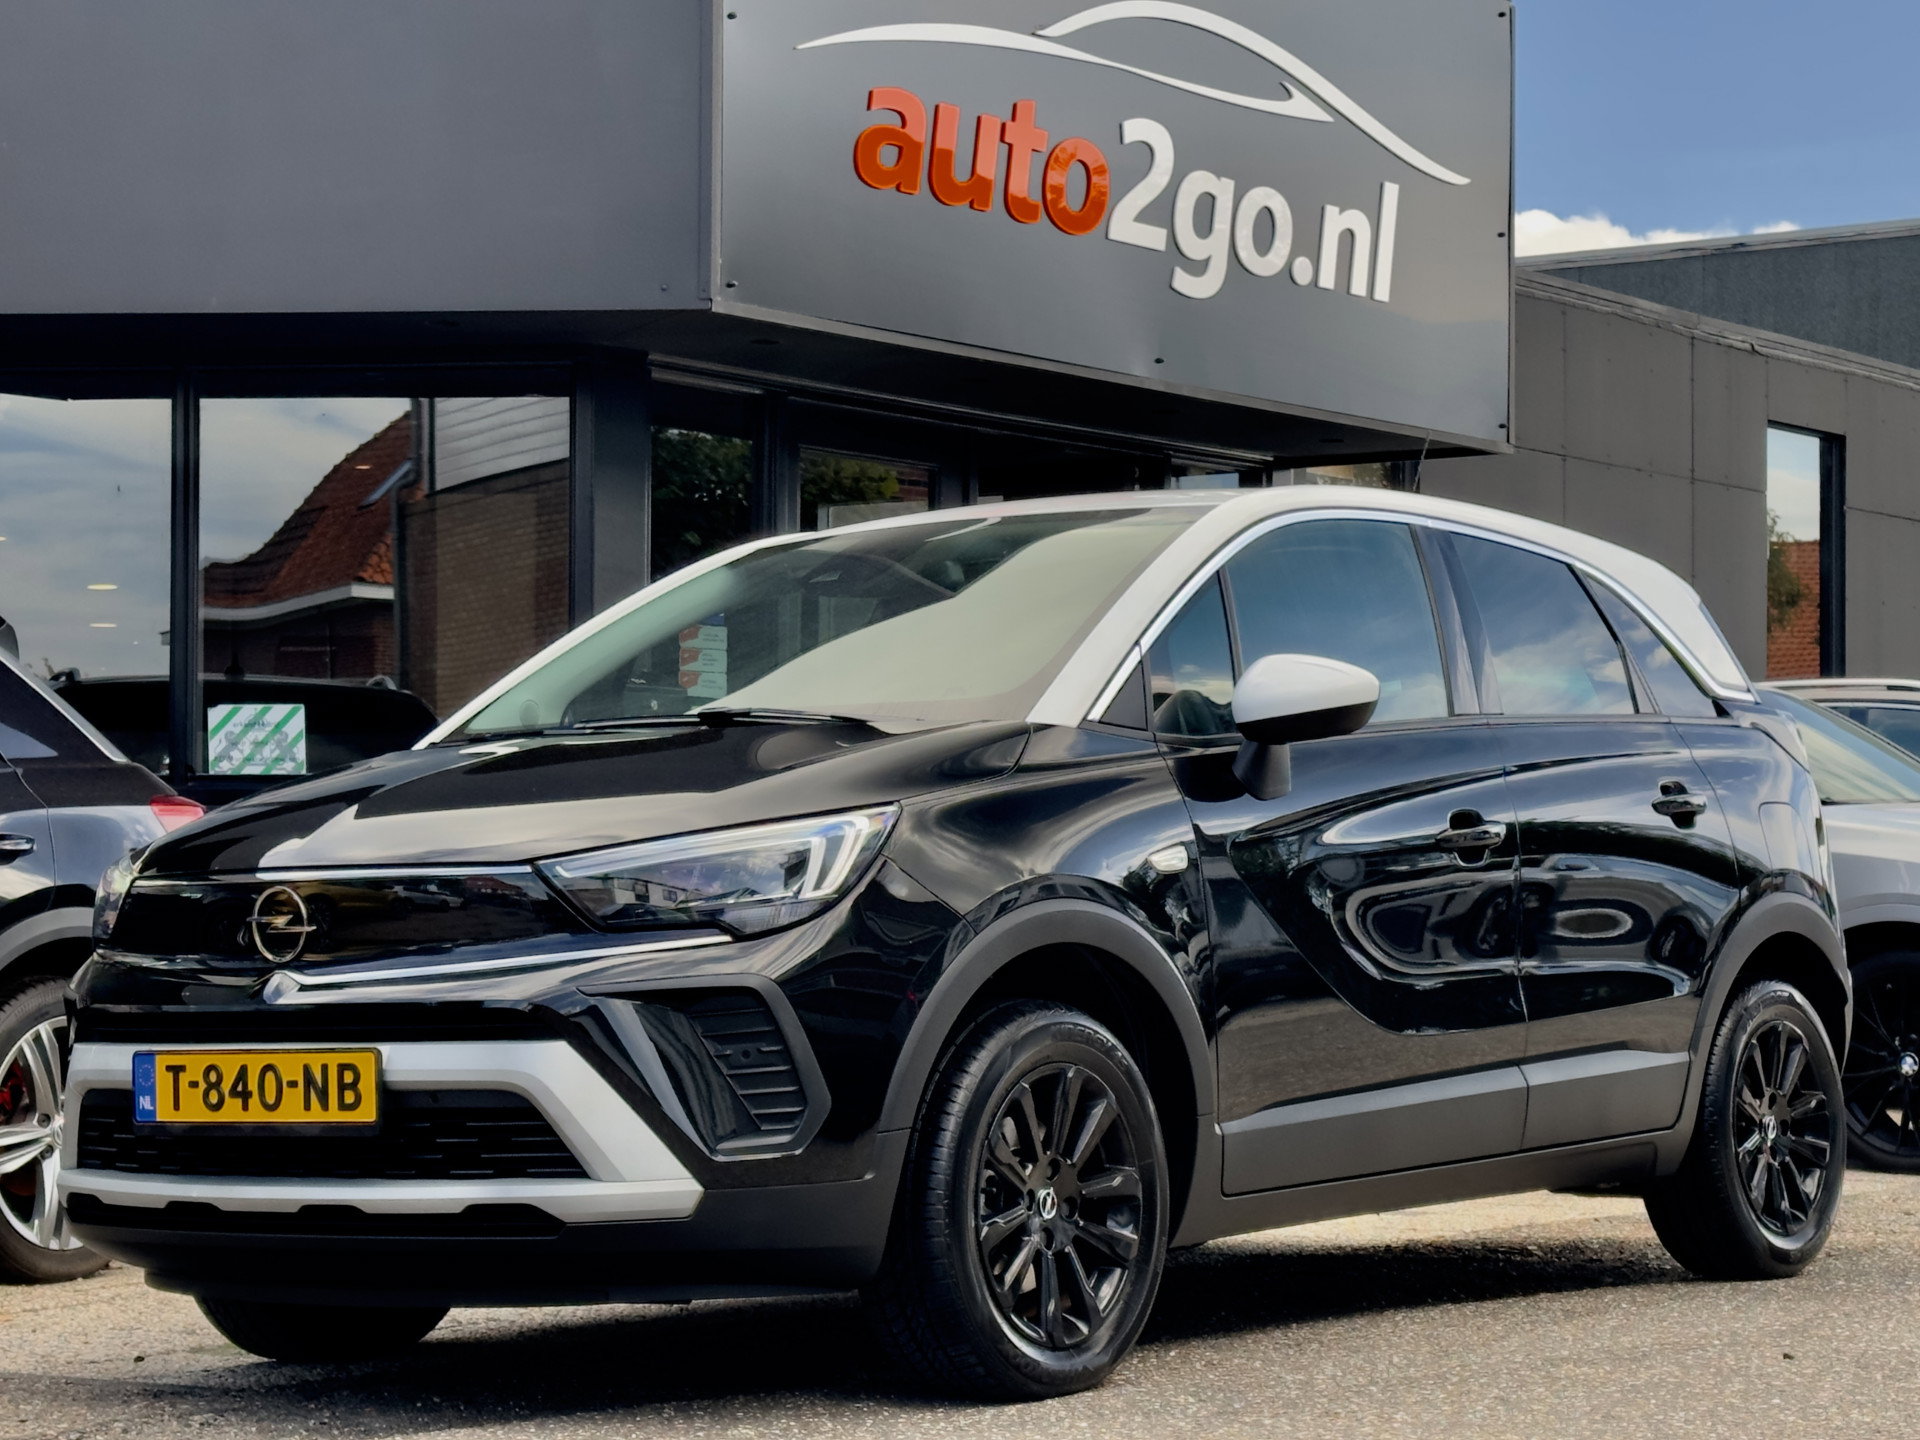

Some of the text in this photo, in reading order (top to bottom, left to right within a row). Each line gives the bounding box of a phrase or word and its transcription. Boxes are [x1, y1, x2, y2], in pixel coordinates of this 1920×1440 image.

[853, 86, 1400, 301] auto2go.nl
[139, 1095, 154, 1110] NL
[164, 1062, 363, 1112] T-840-NB
